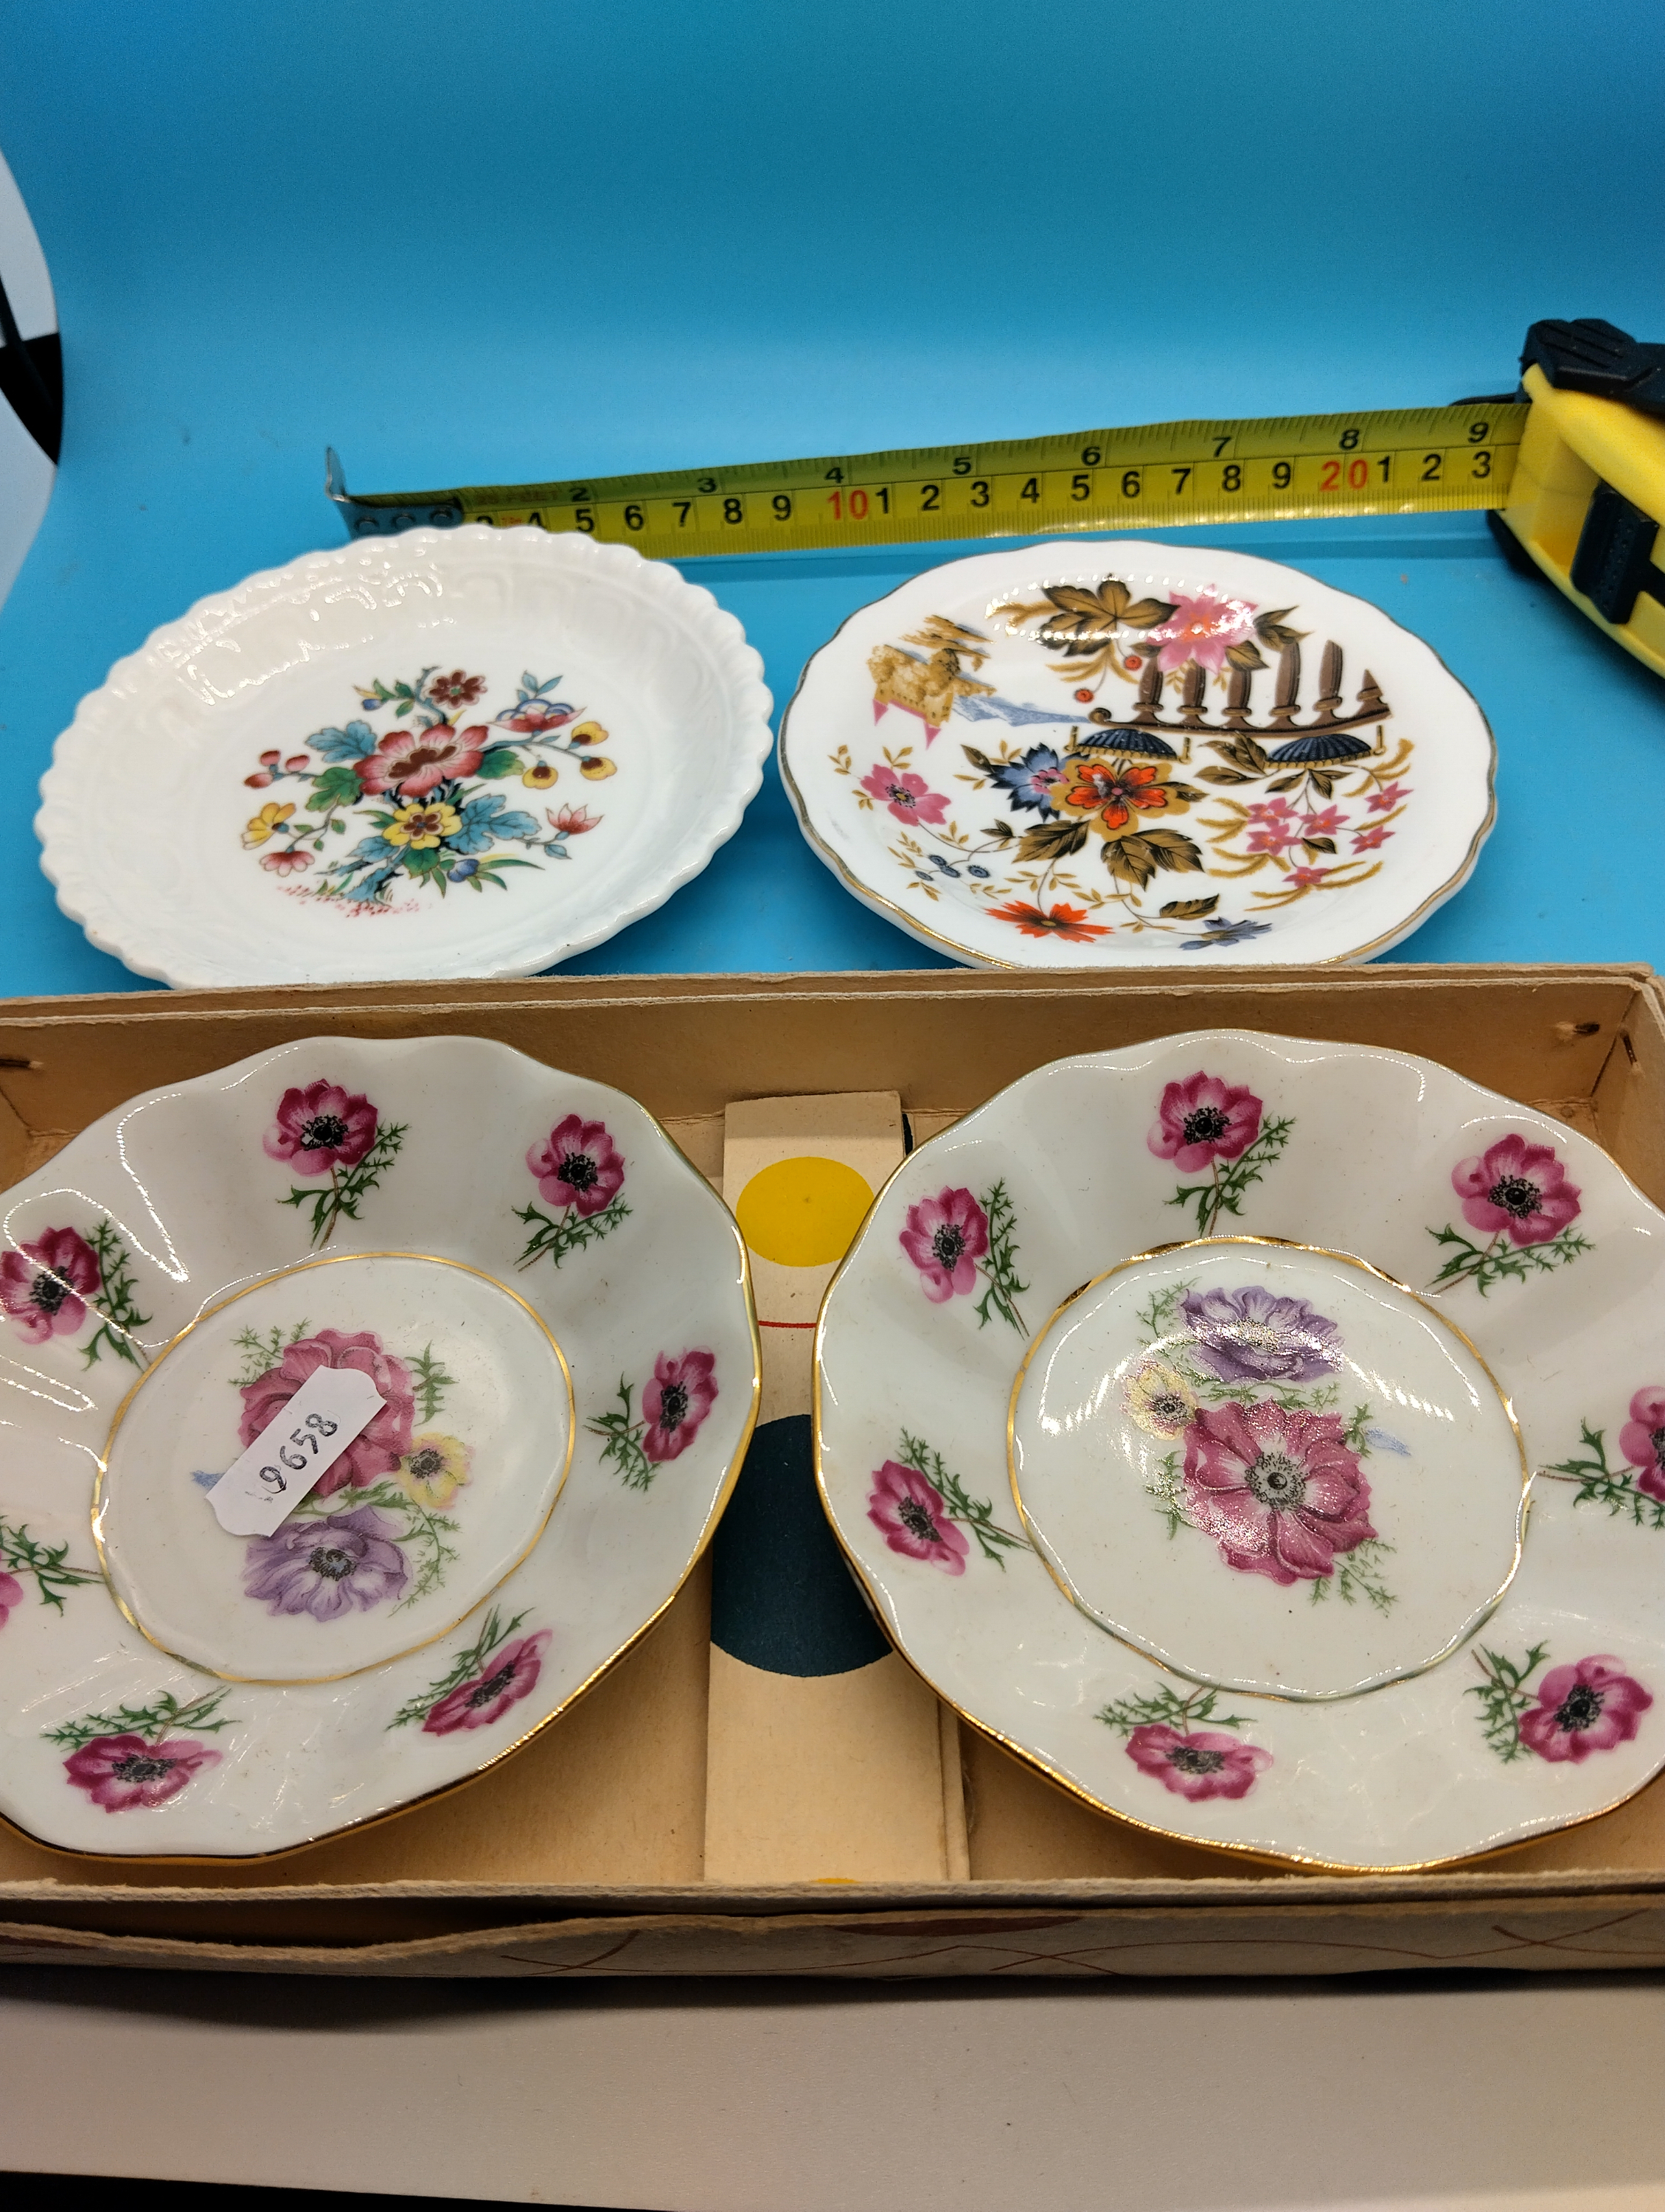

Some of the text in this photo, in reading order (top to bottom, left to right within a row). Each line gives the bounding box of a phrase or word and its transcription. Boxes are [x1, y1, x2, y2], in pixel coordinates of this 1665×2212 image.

[569, 487, 589, 502] 2
[698, 478, 717, 493] 3
[825, 467, 844, 484] 4
[953, 456, 971, 475] 5
[1082, 446, 1101, 466] 6
[1212, 437, 1231, 457] 7
[1339, 429, 1360, 450] 8
[1468, 422, 1489, 443] 9
[575, 509, 594, 532] 5
[625, 505, 644, 531] 6
[672, 501, 691, 526] 7
[723, 498, 743, 524] 8
[773, 495, 791, 521] 9
[827, 490, 869, 520] 10
[875, 488, 889, 513] 1
[921, 485, 939, 511] 2
[970, 481, 990, 507] 3
[1021, 478, 1040, 503] 4
[1071, 475, 1090, 501] 5
[1122, 471, 1140, 498] 6
[1172, 468, 1192, 495] 7
[1222, 465, 1241, 492] 8
[1272, 462, 1290, 489] 9
[1320, 459, 1368, 492] 20
[1377, 456, 1390, 482] 1
[1422, 453, 1442, 481] 2
[1472, 451, 1491, 479] 3
